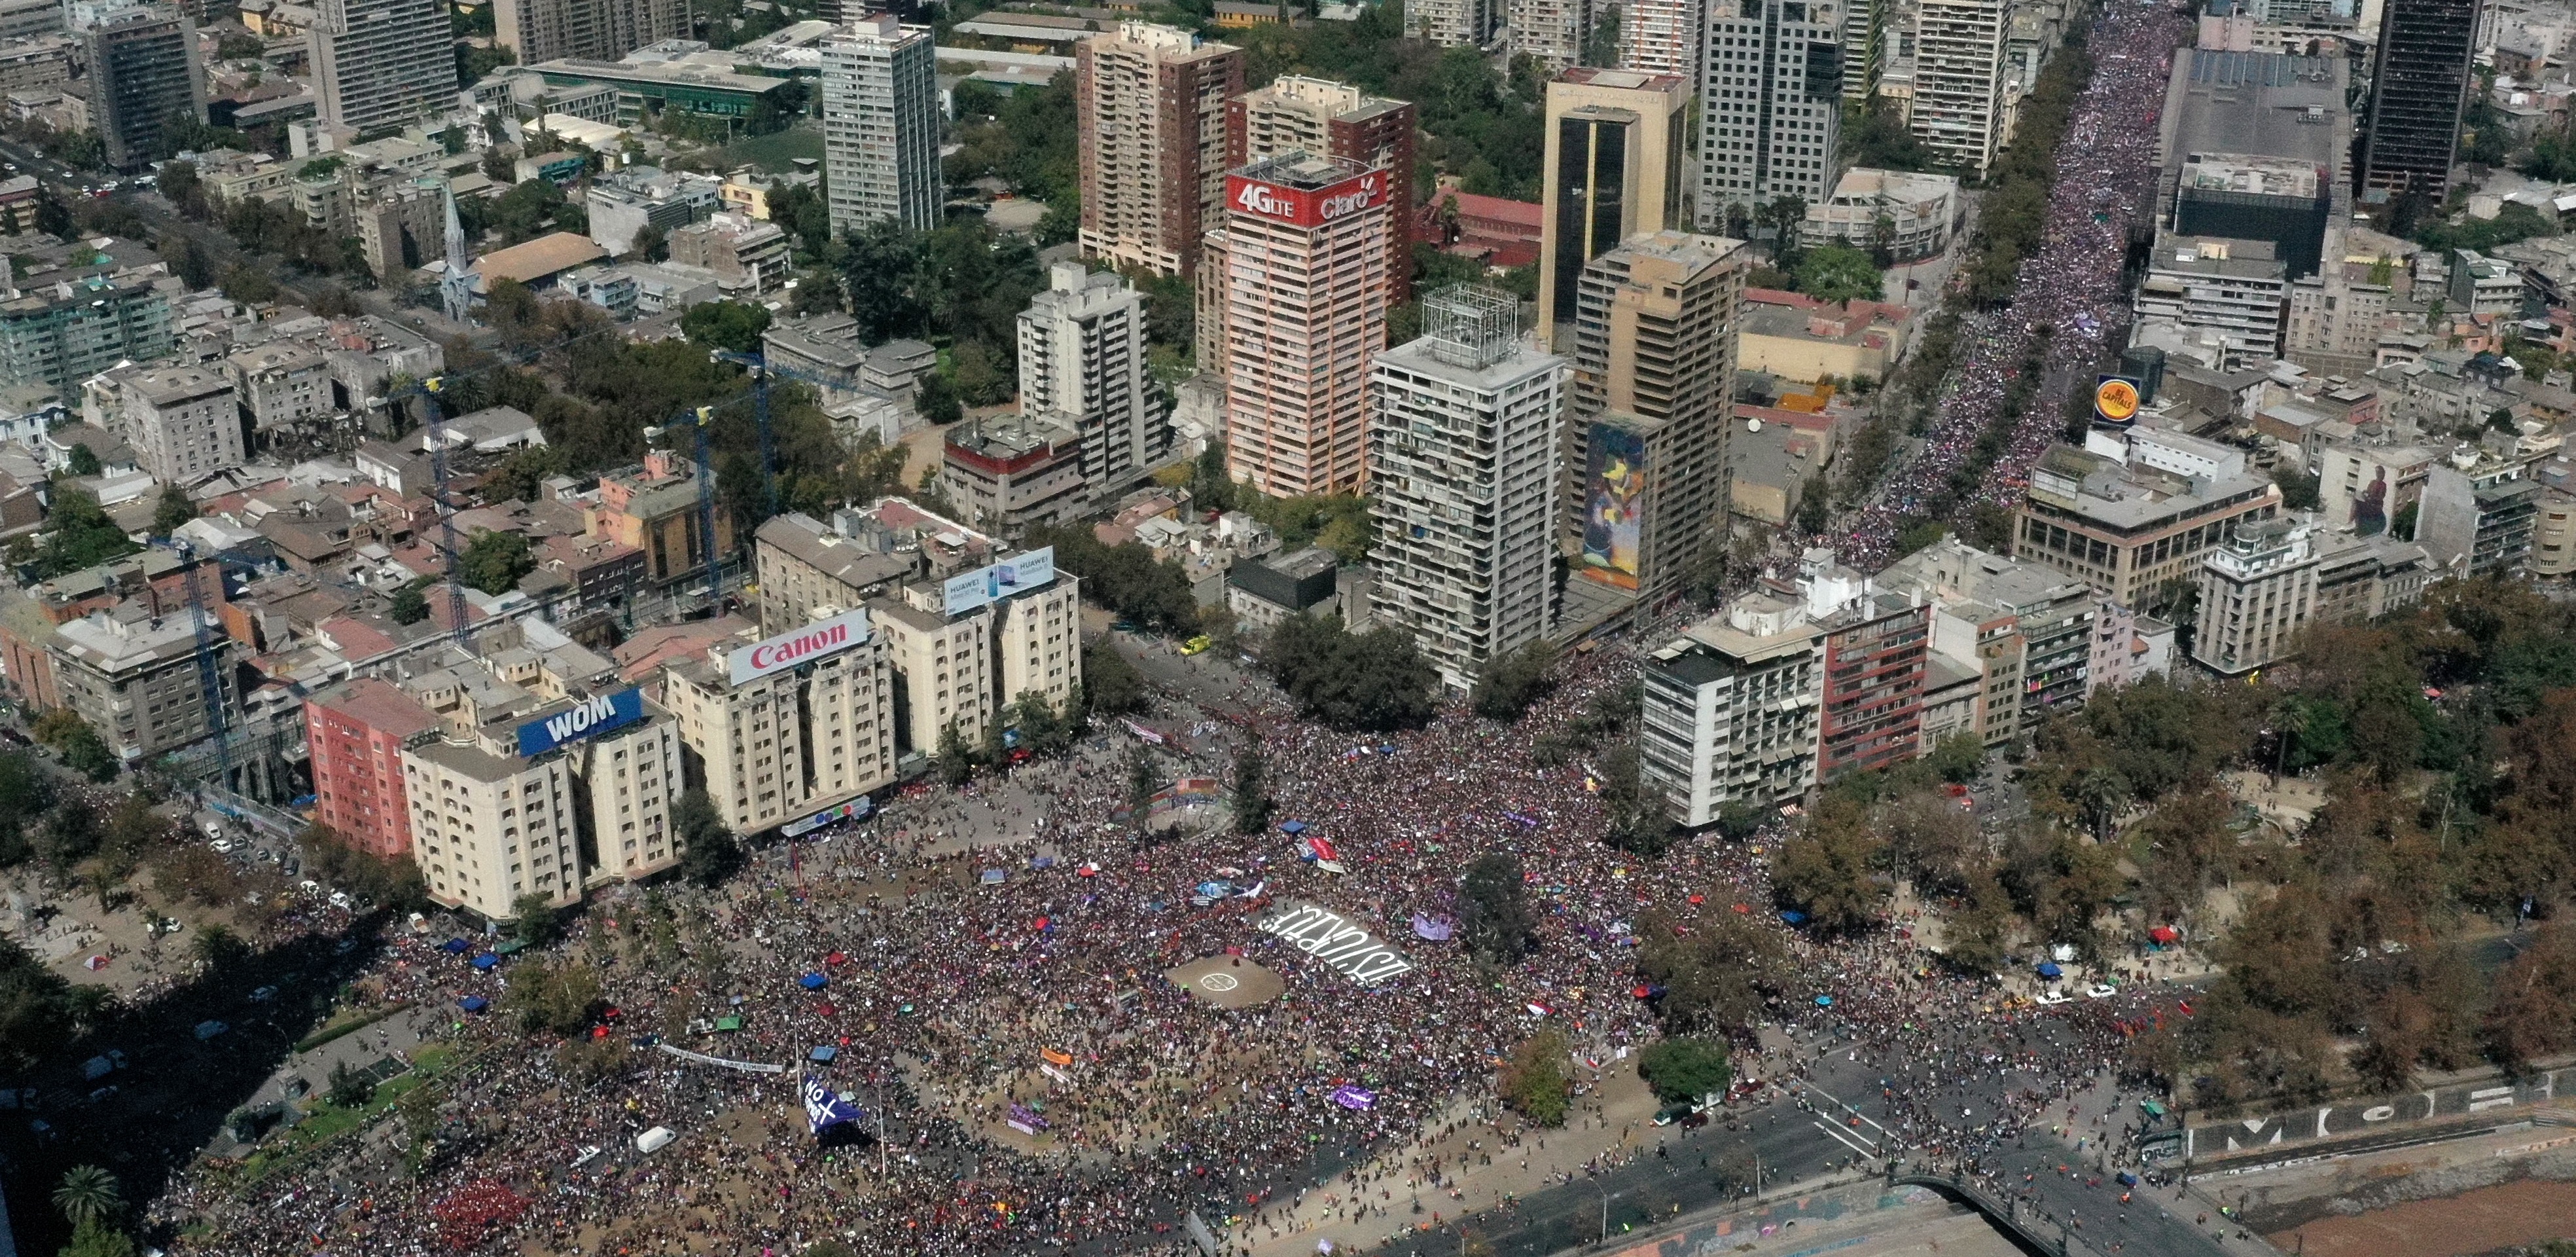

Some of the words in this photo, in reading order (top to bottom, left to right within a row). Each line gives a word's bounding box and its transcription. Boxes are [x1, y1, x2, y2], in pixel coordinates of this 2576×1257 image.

[1320, 191, 1368, 220] Claro
[1020, 556, 1048, 570] HUAWEI
[950, 578, 980, 593] HUAWEI
[751, 623, 848, 669] Canon
[546, 694, 616, 742] WOM
[805, 1080, 825, 1102] NO
